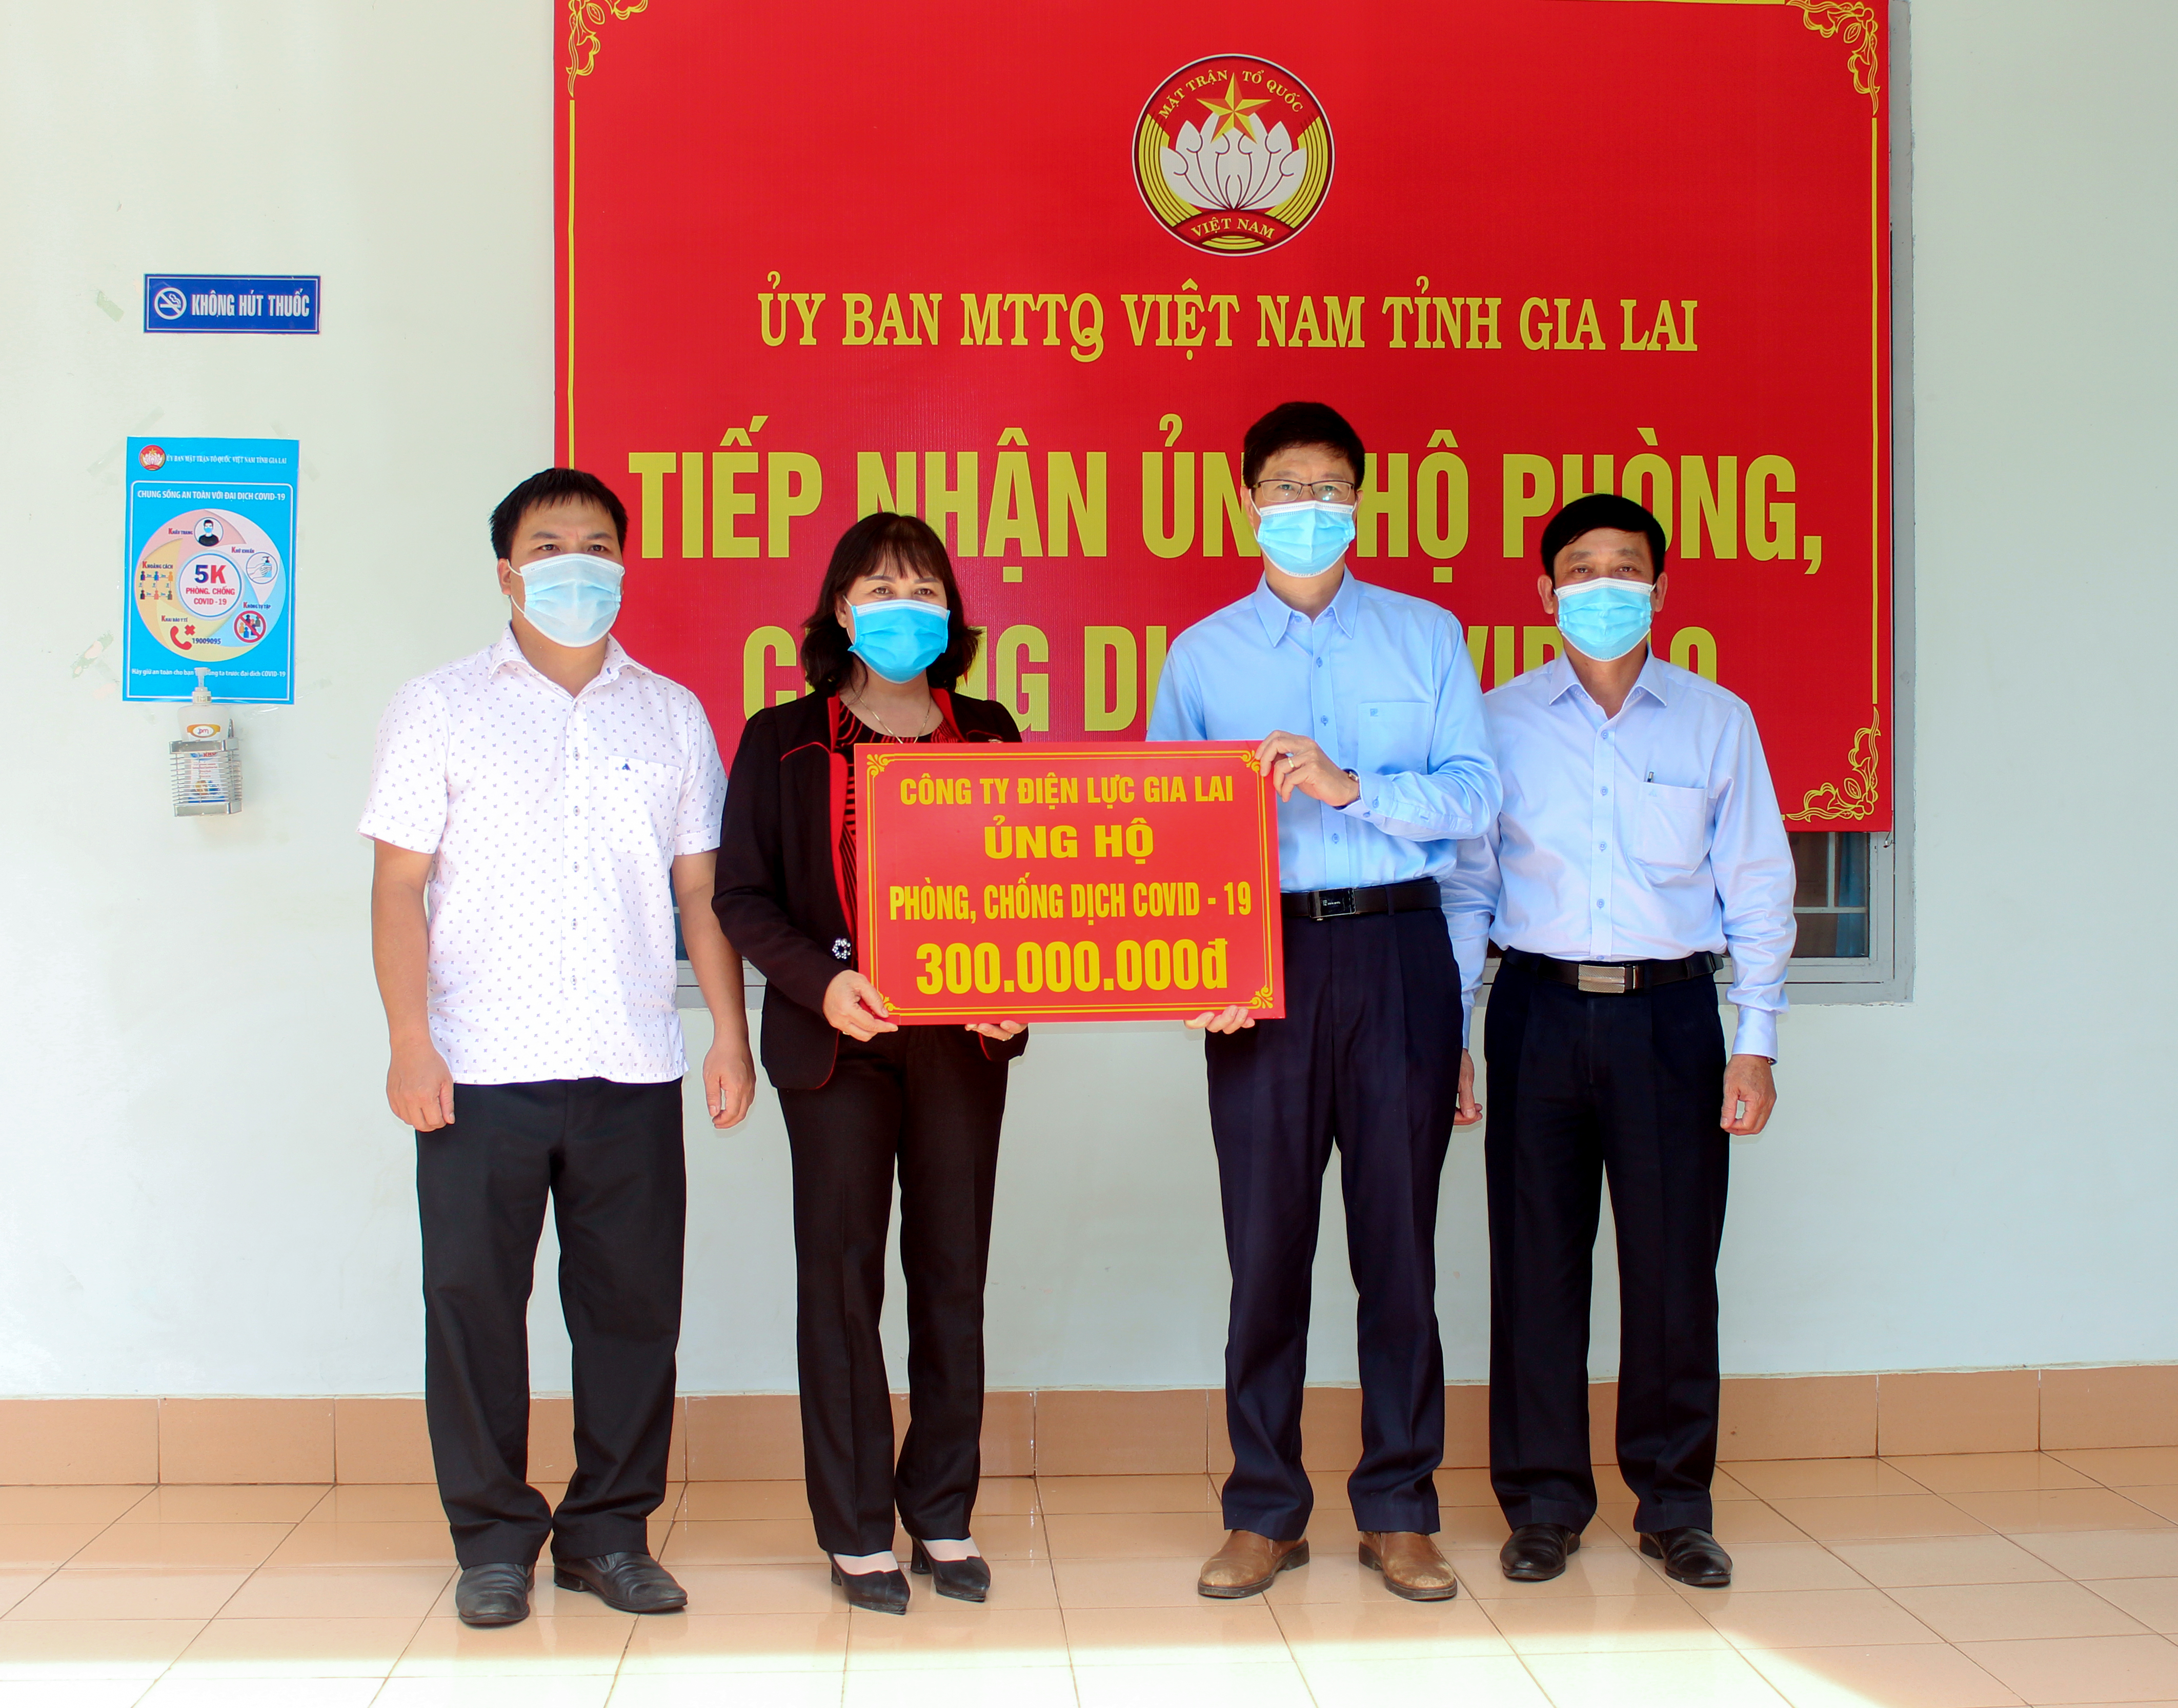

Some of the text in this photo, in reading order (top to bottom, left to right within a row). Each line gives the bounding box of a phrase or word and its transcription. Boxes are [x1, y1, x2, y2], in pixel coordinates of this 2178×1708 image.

[1159, 70, 1303, 118] MẶT TRẬN TỔ QUỐC
[1191, 217, 1275, 239] VIỆT NAM
[191, 288, 310, 317] KHÔNG HÚT THUỐC
[758, 271, 1698, 363] ỦY BAN MTTQ VIỆT NAM TỈNH GIA LAI
[137, 488, 286, 502] CHUNG SỐNG AN TOÀN VỚI ĐẠI DỊCH COVID-19
[629, 415, 822, 559] TIẾP
[857, 427, 1107, 582] NHẬN
[1142, 413, 1261, 558] ỦN
[1356, 429, 1469, 582] HỘ
[194, 565, 227, 584] 5K
[212, 586, 235, 595] CHỐNG
[900, 772, 1234, 810] CÔNG TY ĐIỆN LỰC GIA LAI
[984, 814, 1154, 865] ỦNG HỘ
[889, 877, 977, 924] PHÒNG,
[983, 872, 1064, 920] CHỐNG
[1071, 882, 1126, 926] DỊCH
[1133, 881, 1200, 917] COVID
[1223, 881, 1252, 915] 19
[916, 938, 1228, 995] 300.000.000đ
